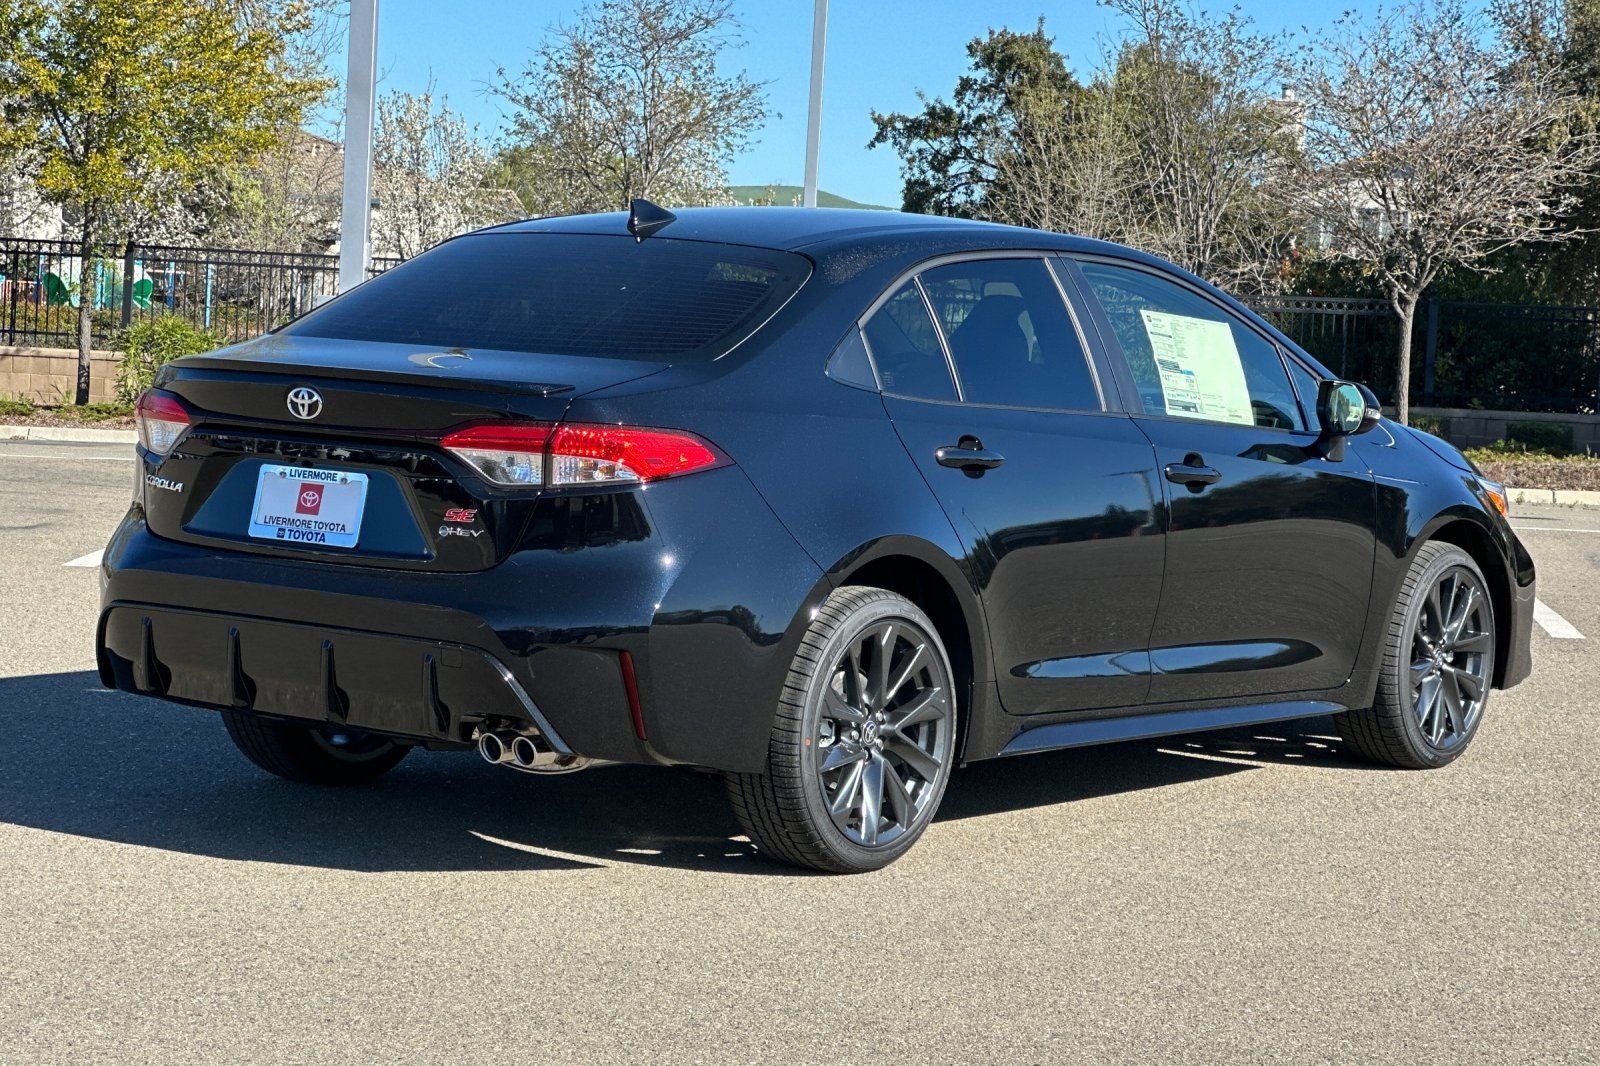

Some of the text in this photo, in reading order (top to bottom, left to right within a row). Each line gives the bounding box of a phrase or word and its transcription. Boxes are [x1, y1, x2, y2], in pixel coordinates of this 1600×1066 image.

[289, 469, 338, 482] LIVERMORE
[146, 474, 183, 493] COROLLA
[443, 508, 478, 523] SE
[263, 515, 346, 533] LIVERMORE TOYOTA
[287, 528, 326, 543] TOYOTA
